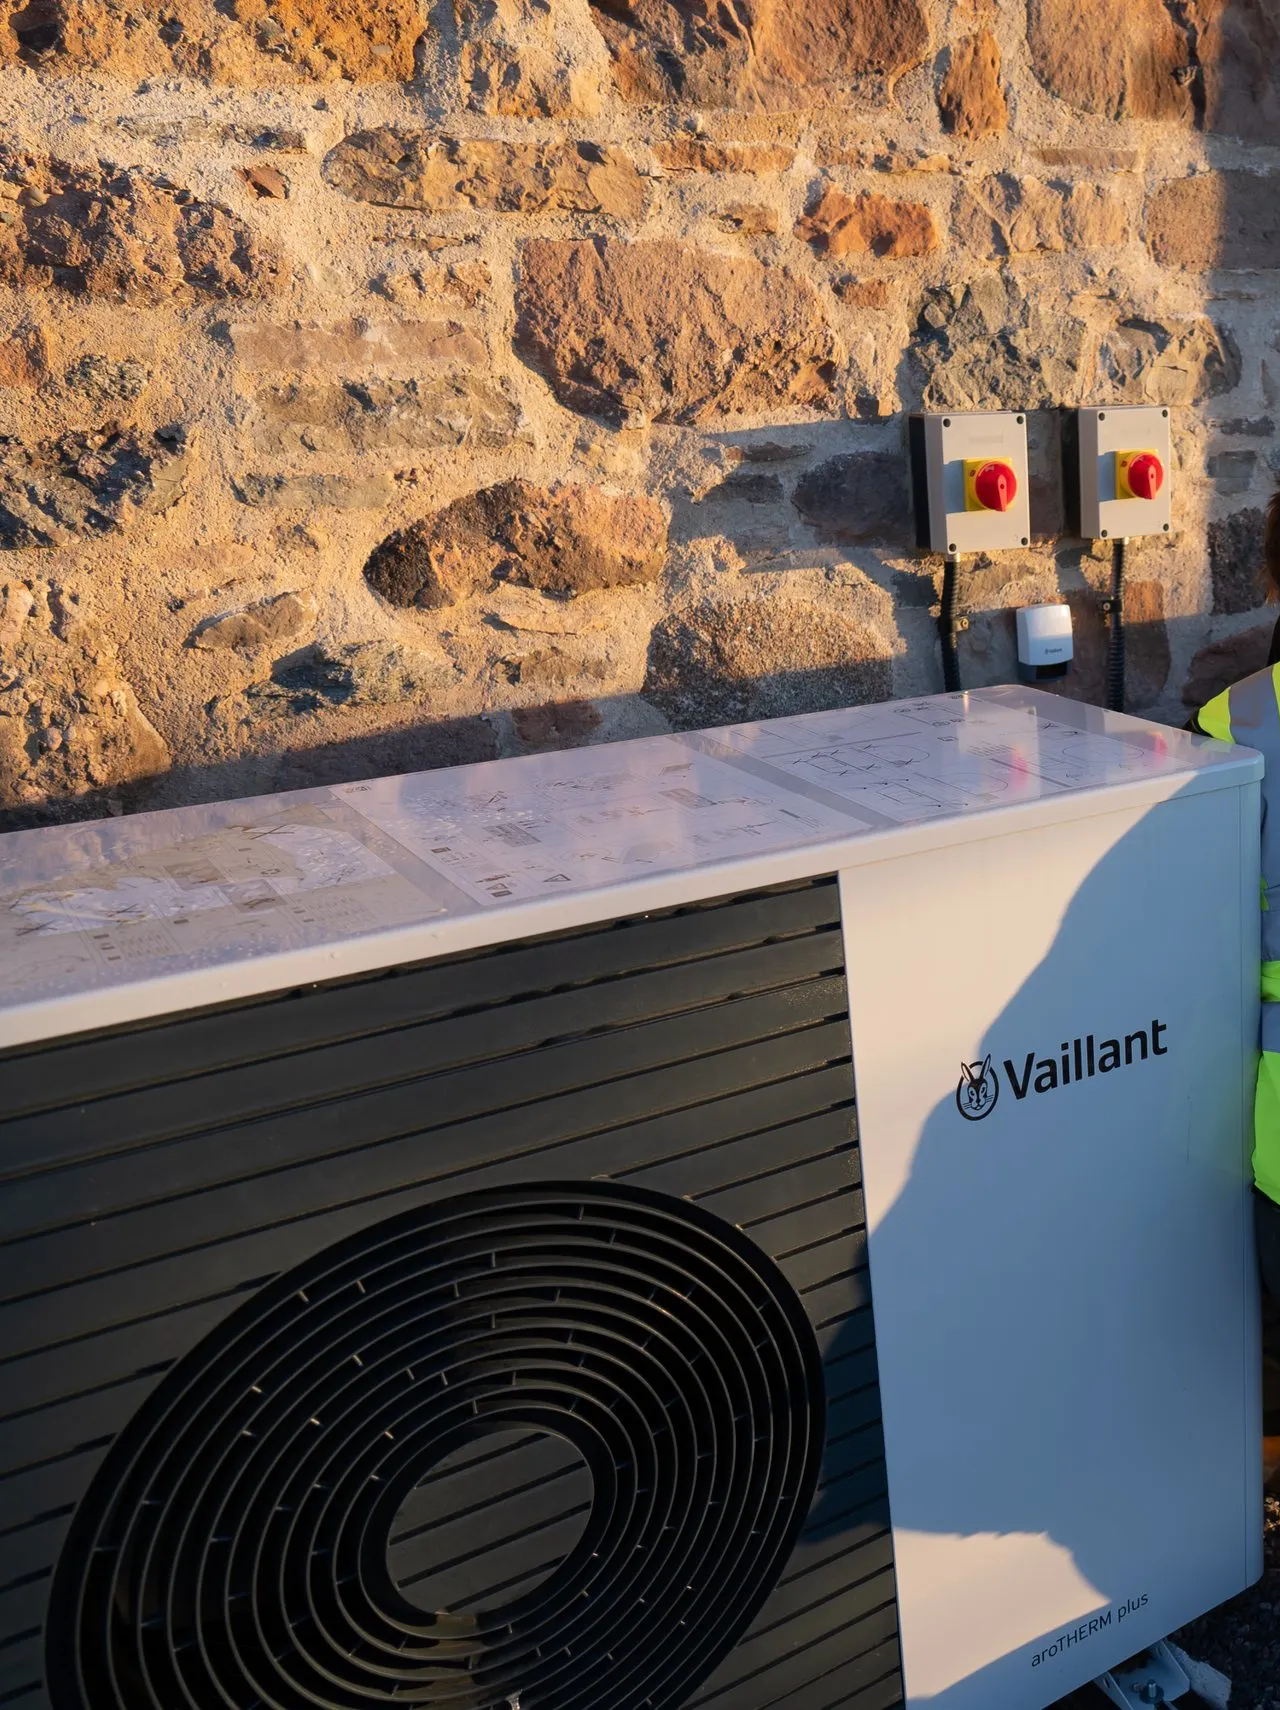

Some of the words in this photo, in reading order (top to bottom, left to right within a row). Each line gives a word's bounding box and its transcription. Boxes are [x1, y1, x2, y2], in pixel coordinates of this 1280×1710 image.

[1003, 1019, 1168, 1100] Vaillant
[1031, 1610, 1112, 1667] aroTHERM
[1117, 1593, 1149, 1623] plus
